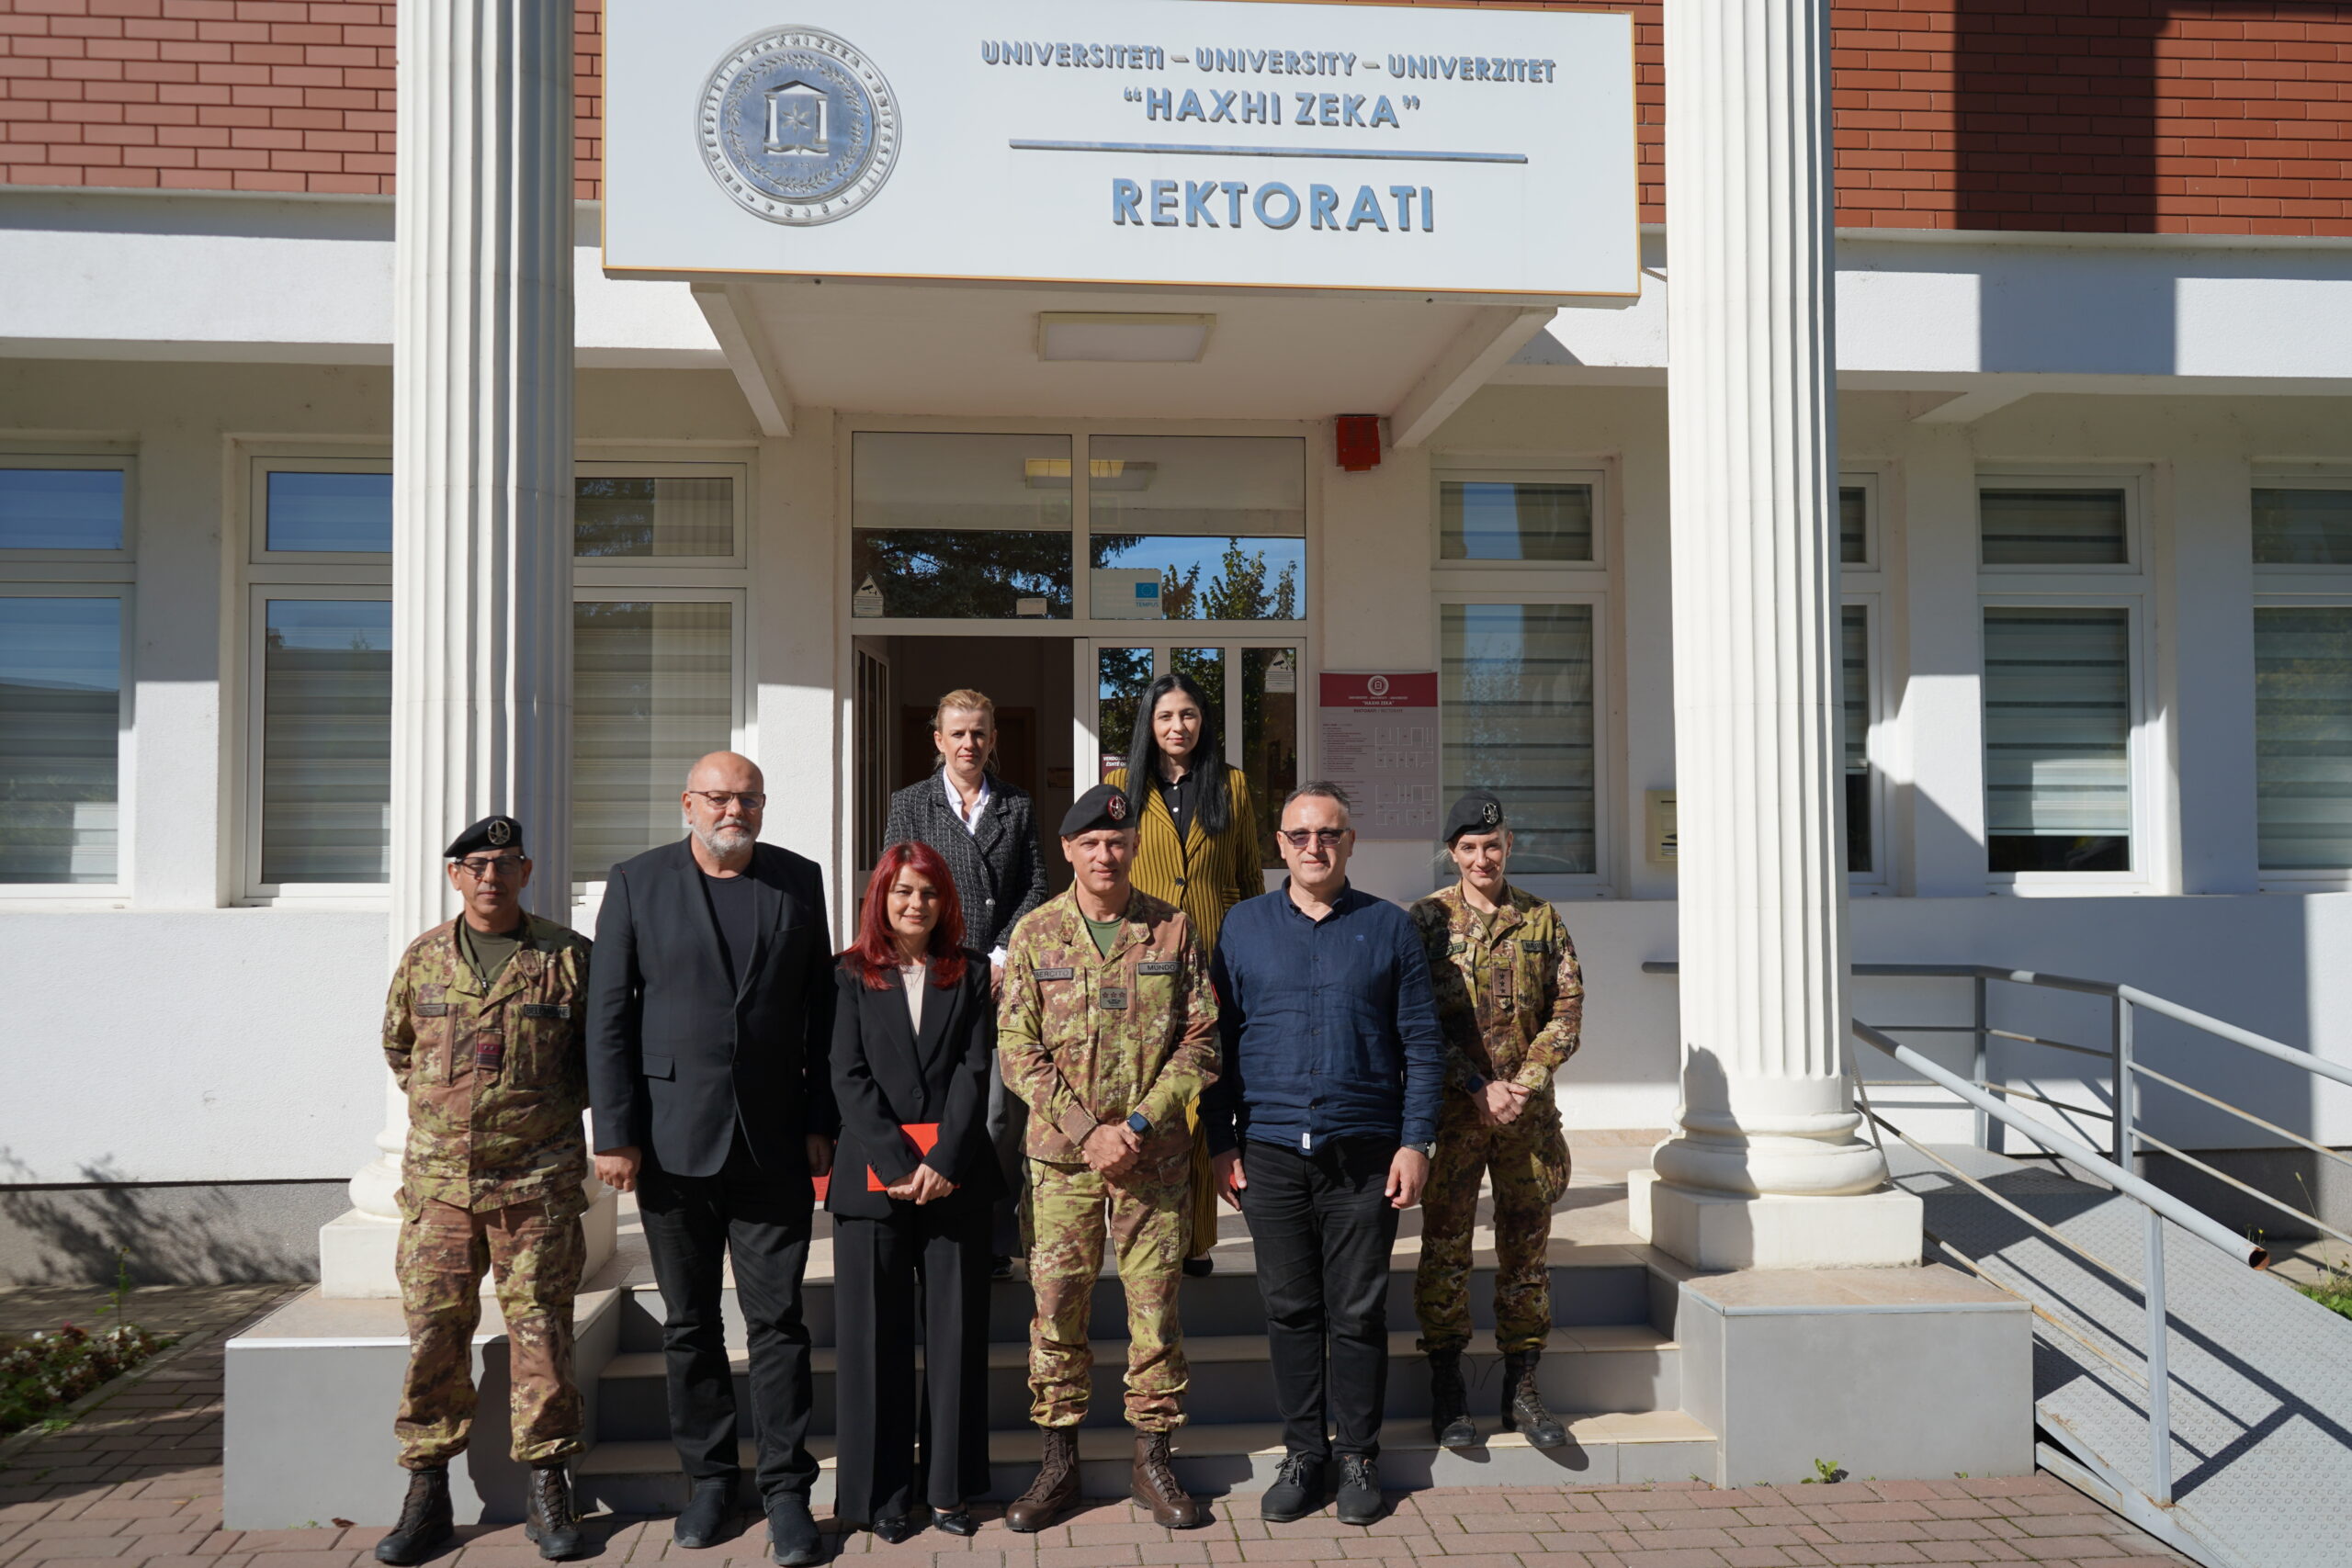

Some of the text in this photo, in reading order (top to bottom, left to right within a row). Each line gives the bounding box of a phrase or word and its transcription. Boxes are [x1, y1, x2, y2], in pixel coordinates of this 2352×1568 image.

[981, 39, 1164, 70] UNIVERSITETI
[1195, 47, 1356, 76] UNIVERSITY
[1388, 53, 1556, 83] UNIVERZITET
[1113, 177, 1434, 232] REKTORATI
